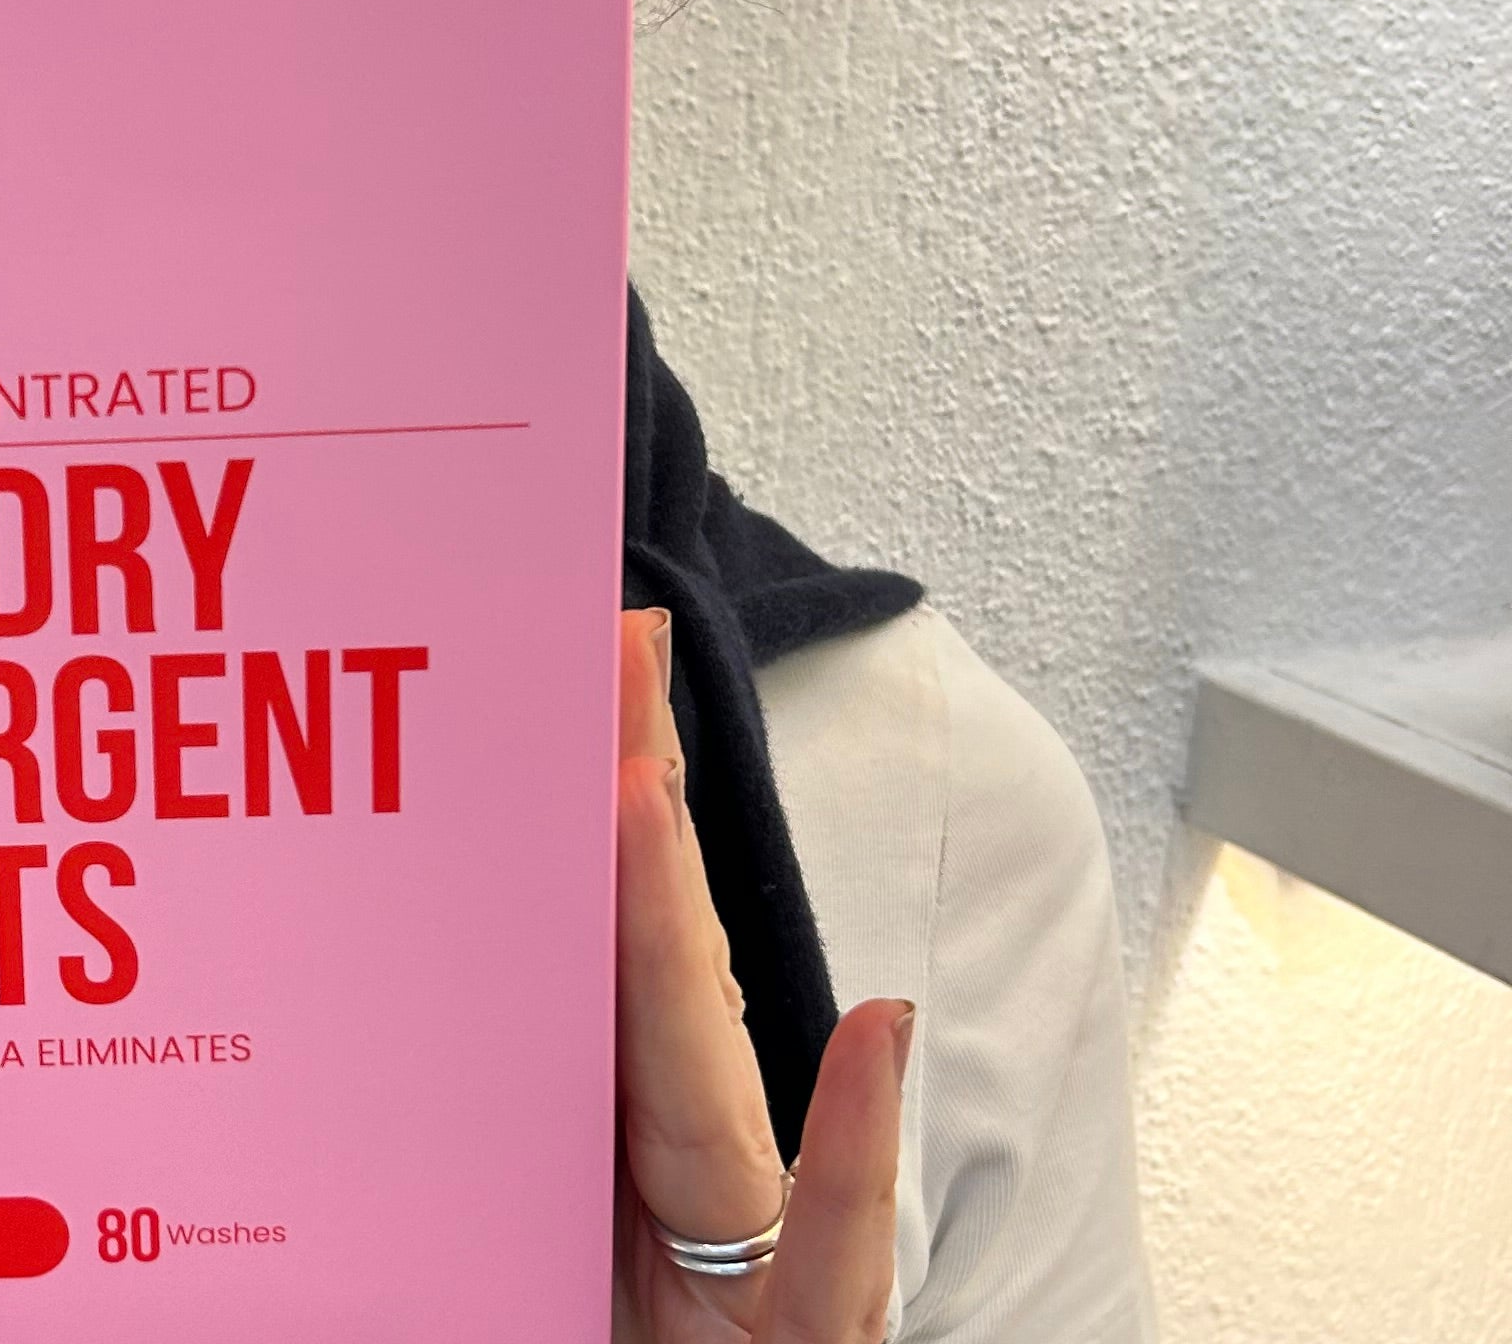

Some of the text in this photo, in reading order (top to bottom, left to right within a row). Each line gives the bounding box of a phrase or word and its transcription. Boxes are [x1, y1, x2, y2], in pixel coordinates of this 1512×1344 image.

[39, 1034, 250, 1066] ELIMINATES
[98, 1208, 286, 1263] 80 Washes
